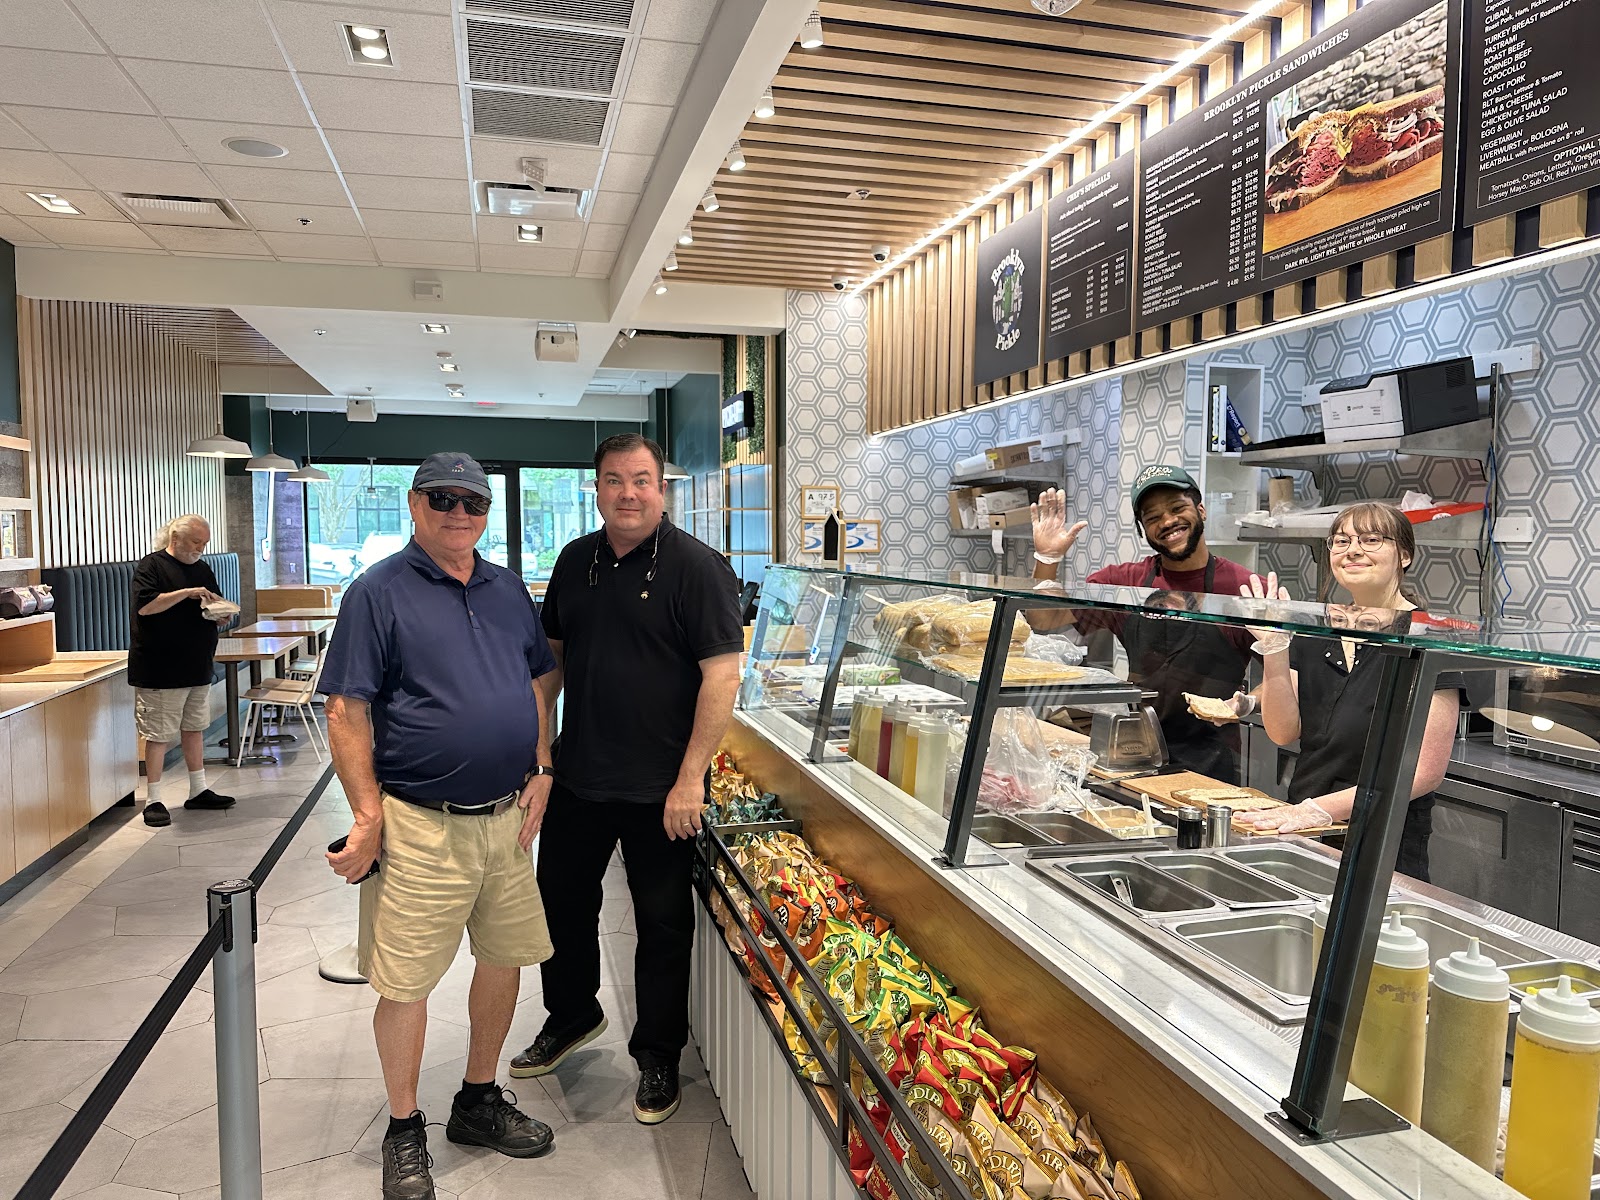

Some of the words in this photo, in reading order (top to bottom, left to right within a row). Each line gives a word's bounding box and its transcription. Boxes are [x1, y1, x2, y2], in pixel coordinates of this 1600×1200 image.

[1484, 27, 1511, 46] TURKEY
[1512, 13, 1539, 32] BREAST
[1540, 2, 1563, 18] Roasted
[1484, 22, 1499, 33] Roast
[1485, 6, 1510, 24] CUBAN
[1484, 34, 1518, 56] PASTRAMI
[1484, 49, 1507, 66] ROAST
[1508, 40, 1526, 56] BEEF
[1204, 88, 1248, 122] BROOKLYN
[1249, 69, 1281, 96] PICKLE
[1282, 28, 1349, 75] SANDWICHES
[1483, 57, 1513, 76] CORNED
[1514, 47, 1532, 62] BEEF
[1483, 61, 1526, 86] CAPOCOLLO
[1482, 83, 1505, 99] ROAST
[1506, 74, 1526, 88] PORK
[1482, 98, 1494, 109] BLT
[1514, 82, 1534, 96] Lettuce
[1541, 70, 1563, 83] Tomato
[1481, 110, 1512, 128] CHICKEN
[1521, 98, 1541, 112] TUNA
[1543, 87, 1568, 103] SALAD
[1482, 106, 1498, 119] HAM
[1506, 91, 1534, 108] CHEESE
[1481, 127, 1496, 138] EGG
[1504, 115, 1524, 129] OLIVE
[1526, 105, 1550, 121] SALAD
[1480, 129, 1523, 152] VEGETARIAN
[1480, 140, 1521, 161] LIVERWURST
[1531, 122, 1568, 142] BOLOGNA
[1480, 153, 1514, 171] MEATBALL
[1515, 149, 1527, 158] with
[1528, 140, 1556, 153] Provolone
[1574, 127, 1585, 136] roll
[1553, 140, 1596, 162] OPTIONAL
[1085, 172, 1111, 193] SPECIALS
[1488, 191, 1509, 201] Horsey
[1510, 184, 1528, 194] Mayo,
[1530, 178, 1542, 187] Sub
[1543, 174, 1554, 183] Oil,
[1556, 169, 1569, 178] Red
[1570, 162, 1588, 172] Wine
[1491, 178, 1521, 192] Tomatoes,
[1522, 170, 1546, 181] Onions,
[1548, 160, 1573, 173] Lettuce,
[1576, 150, 1600, 162] Oregan
[1345, 226, 1359, 234] choice
[1377, 212, 1397, 223] toppings
[1398, 206, 1410, 217] piled
[1411, 203, 1422, 211] high
[1285, 260, 1298, 270] DARK
[1299, 256, 1309, 265] RYE,
[1311, 251, 1325, 261] LIGHT
[1326, 248, 1337, 256] RYE,
[1339, 241, 1355, 252] WHITE
[1364, 231, 1385, 243] WHOLE
[1386, 223, 1407, 235] WHEAT
[991, 248, 1025, 286] Brooklyn
[995, 328, 1020, 350] Pickle
